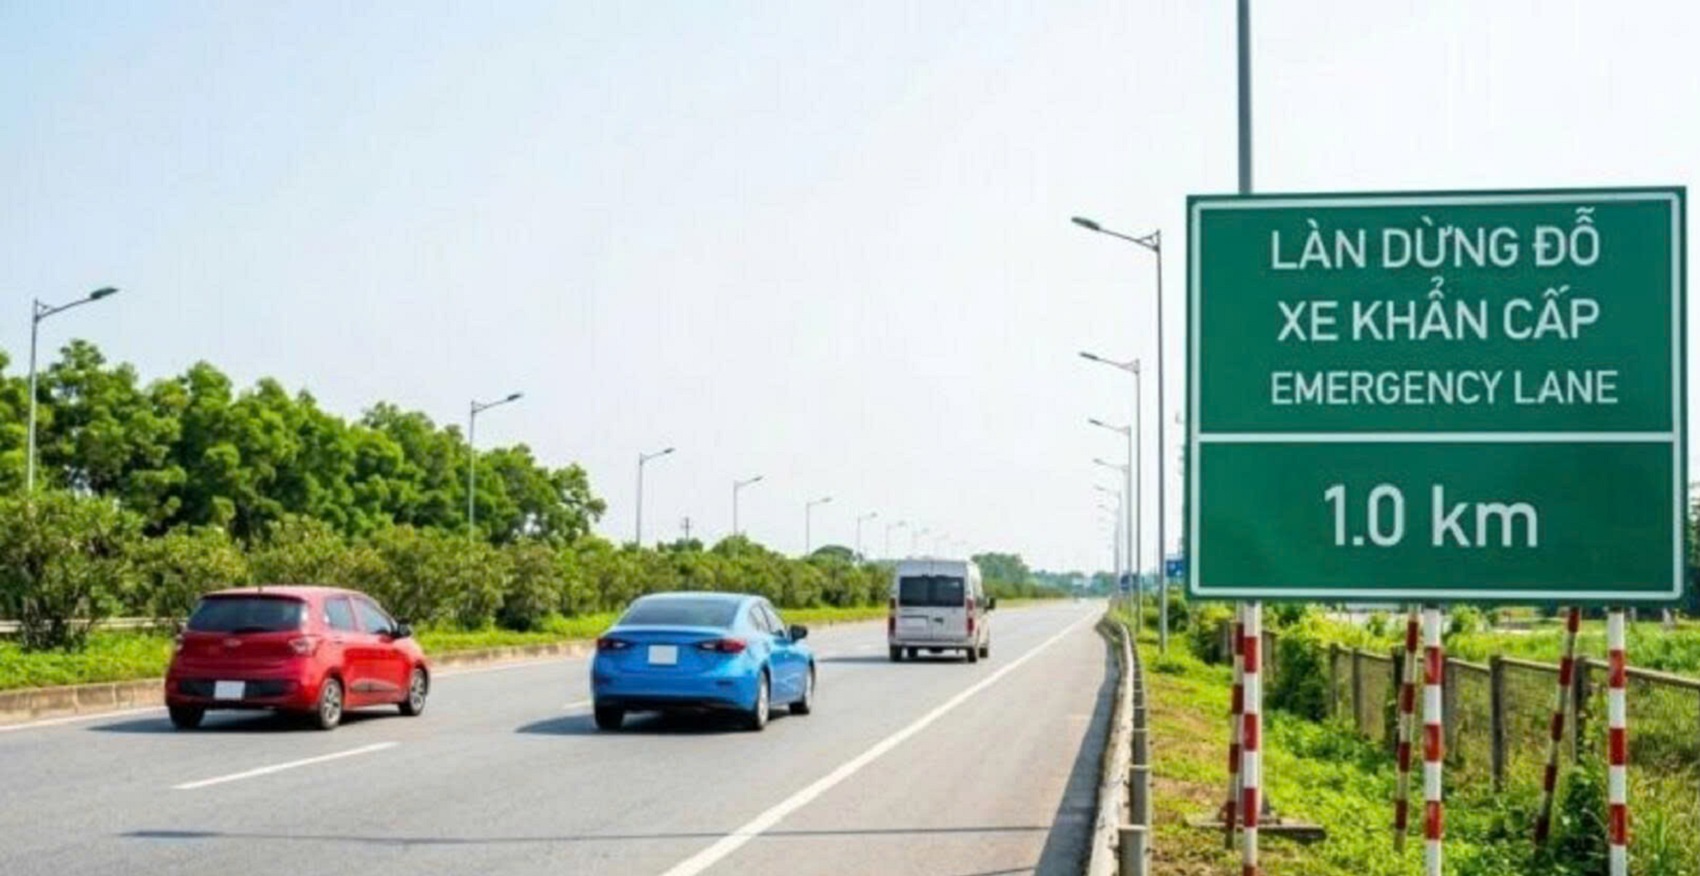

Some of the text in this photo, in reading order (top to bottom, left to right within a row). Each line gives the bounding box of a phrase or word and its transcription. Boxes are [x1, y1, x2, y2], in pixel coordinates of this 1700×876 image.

[1271, 207, 1600, 269] LÀN DỪNG ĐỖ
[1277, 277, 1600, 341] XE KHẨN CẤP
[1271, 370, 1618, 405] EMERGENCY LANE
[1324, 484, 1539, 547] 1.0 km
